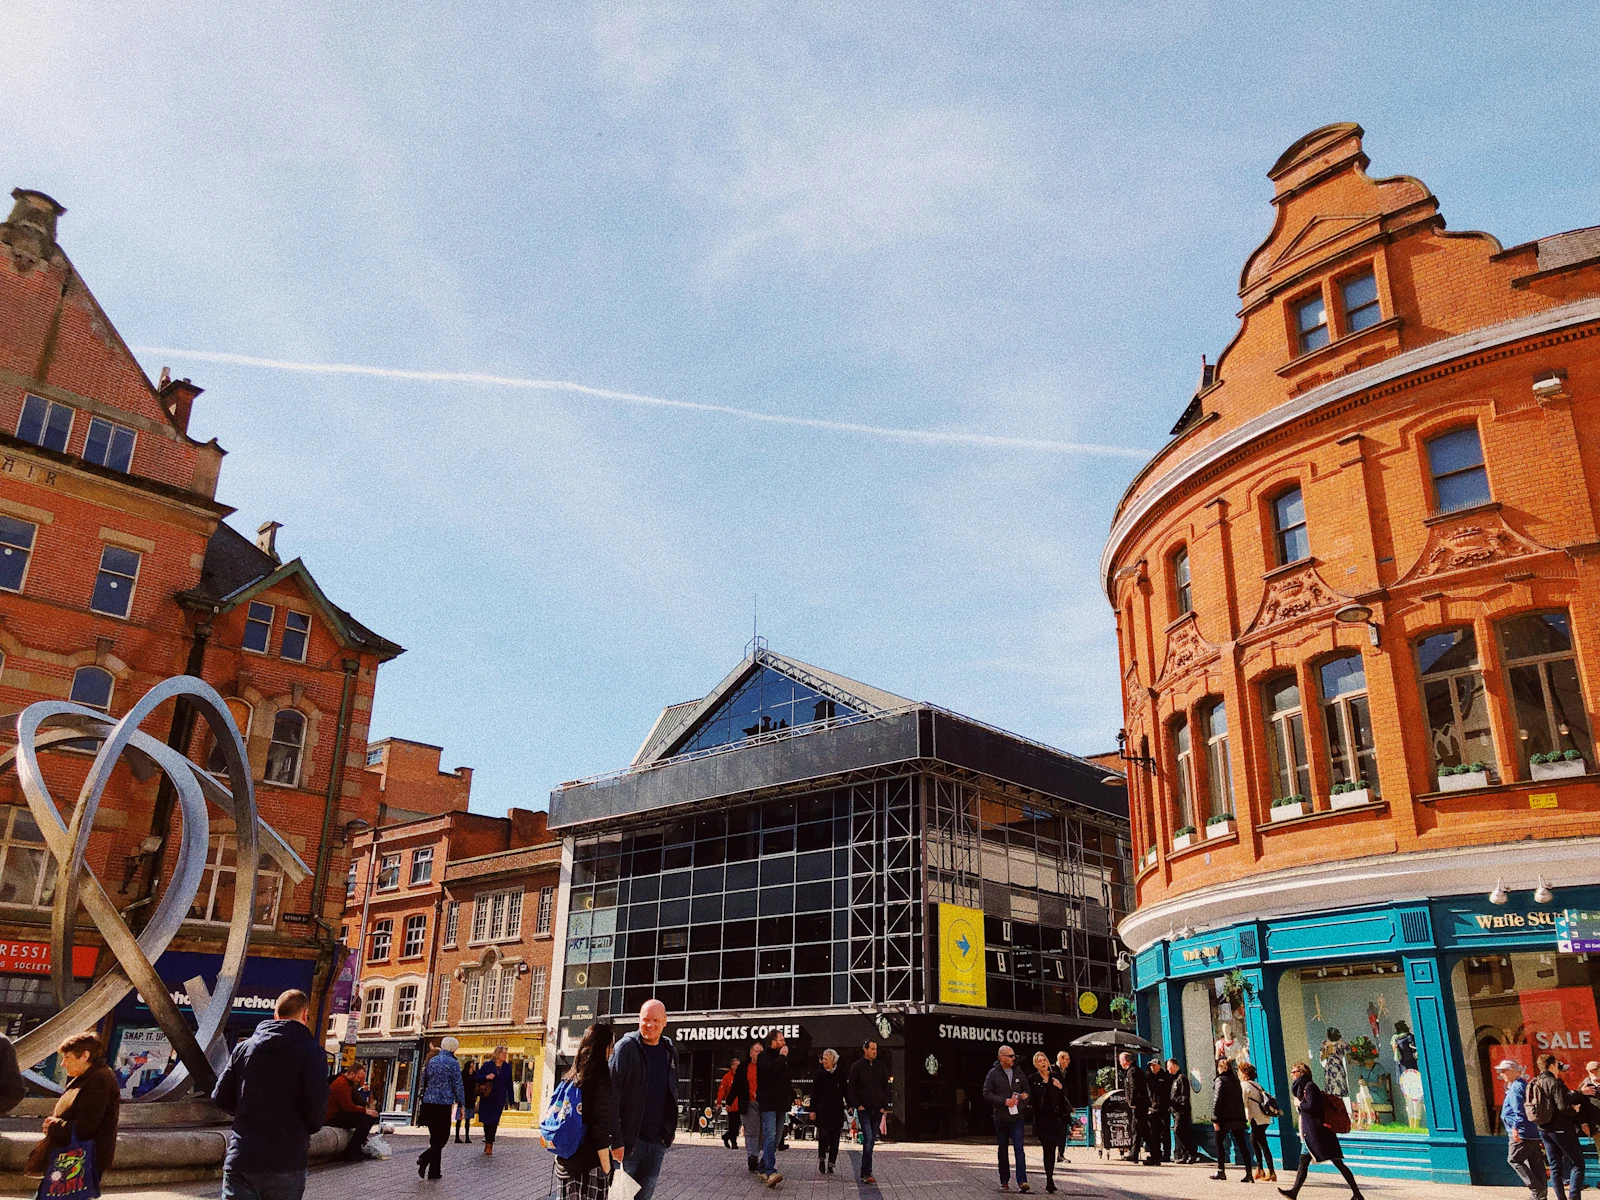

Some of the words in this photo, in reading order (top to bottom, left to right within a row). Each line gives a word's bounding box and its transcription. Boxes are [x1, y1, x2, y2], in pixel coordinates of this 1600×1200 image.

[14, 961, 52, 971] SOCIETY
[676, 1026, 748, 1041] STARBUCKS
[939, 1023, 1005, 1042] STARBUCKS
[1006, 1029, 1044, 1045] COFFEE
[1535, 1030, 1593, 1049] SALE
[1110, 1138, 1132, 1147] TODAY
